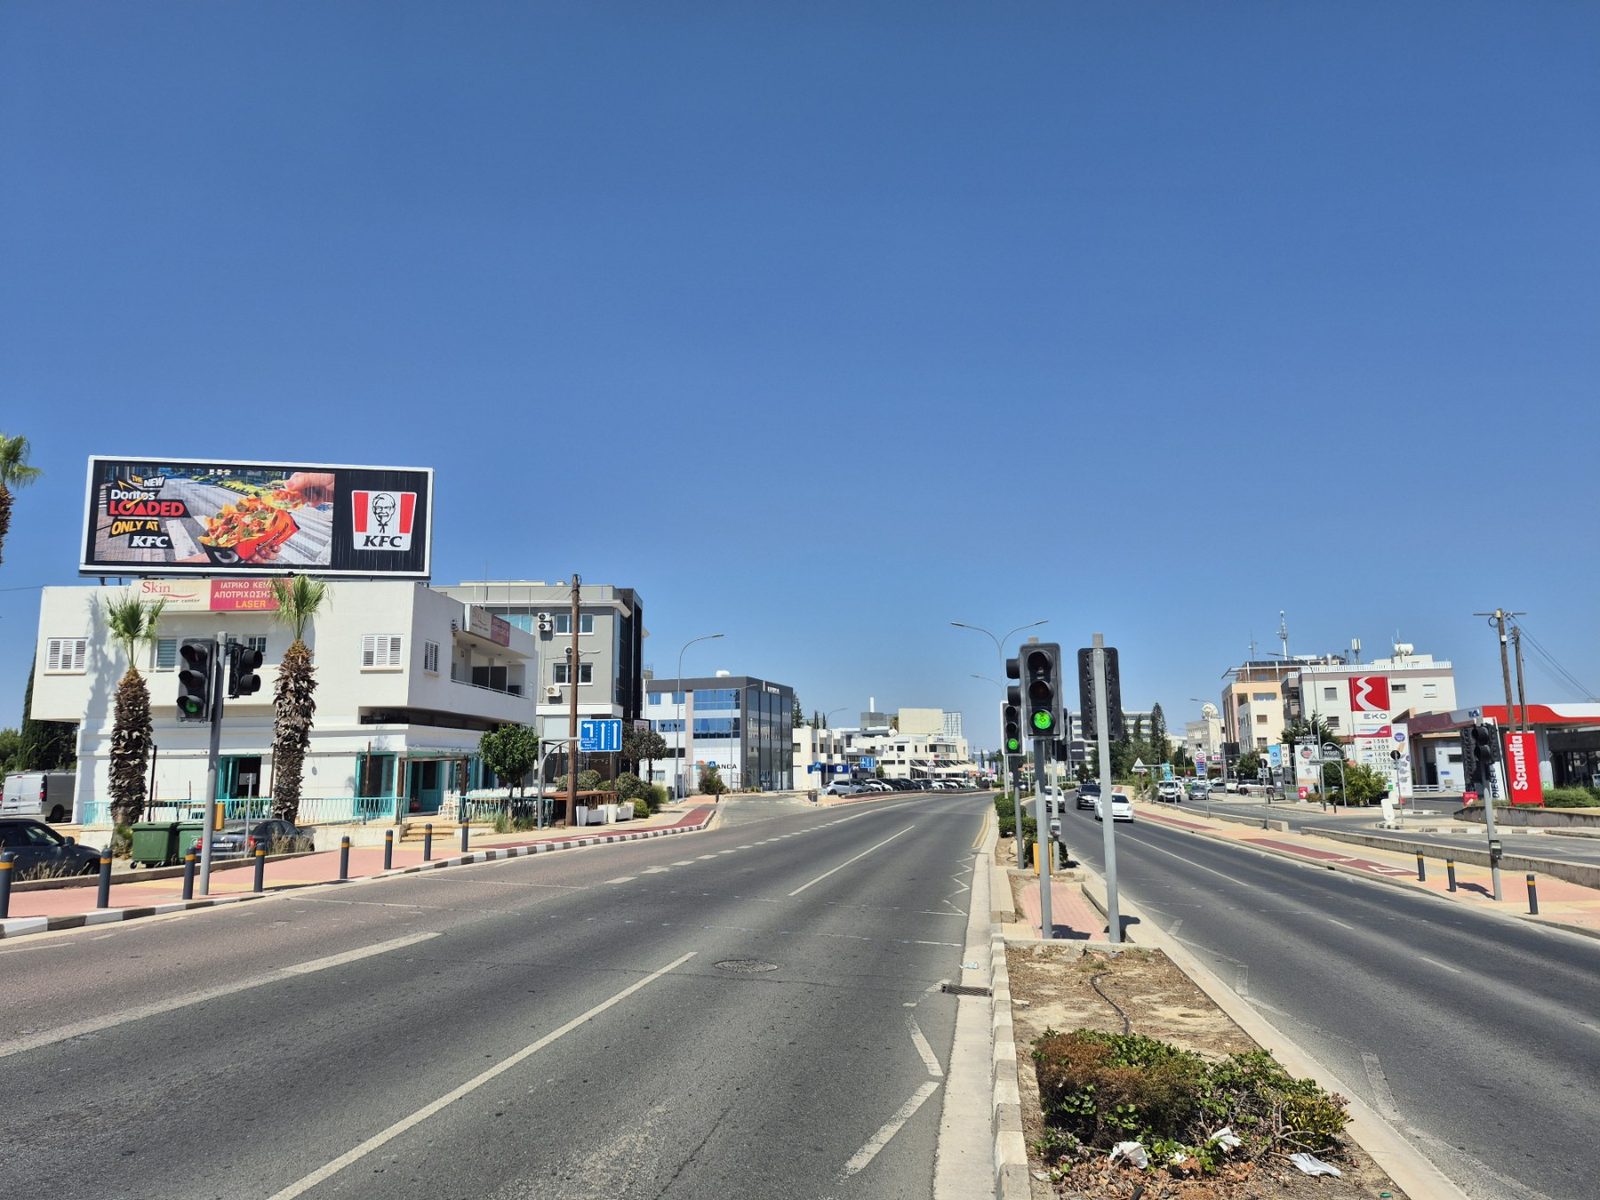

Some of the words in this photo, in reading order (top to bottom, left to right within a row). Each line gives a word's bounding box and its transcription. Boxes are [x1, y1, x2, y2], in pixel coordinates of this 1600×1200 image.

[143, 476, 165, 487] NEW
[111, 489, 155, 500] Doritos
[109, 500, 185, 516] LOADED
[111, 520, 143, 535] ONLY
[145, 521, 159, 531] AT
[130, 535, 169, 547] KFC
[363, 535, 403, 548] KFC
[142, 581, 170, 594] Skin
[235, 600, 266, 608] LASER
[1509, 735, 1528, 791] Scandia
